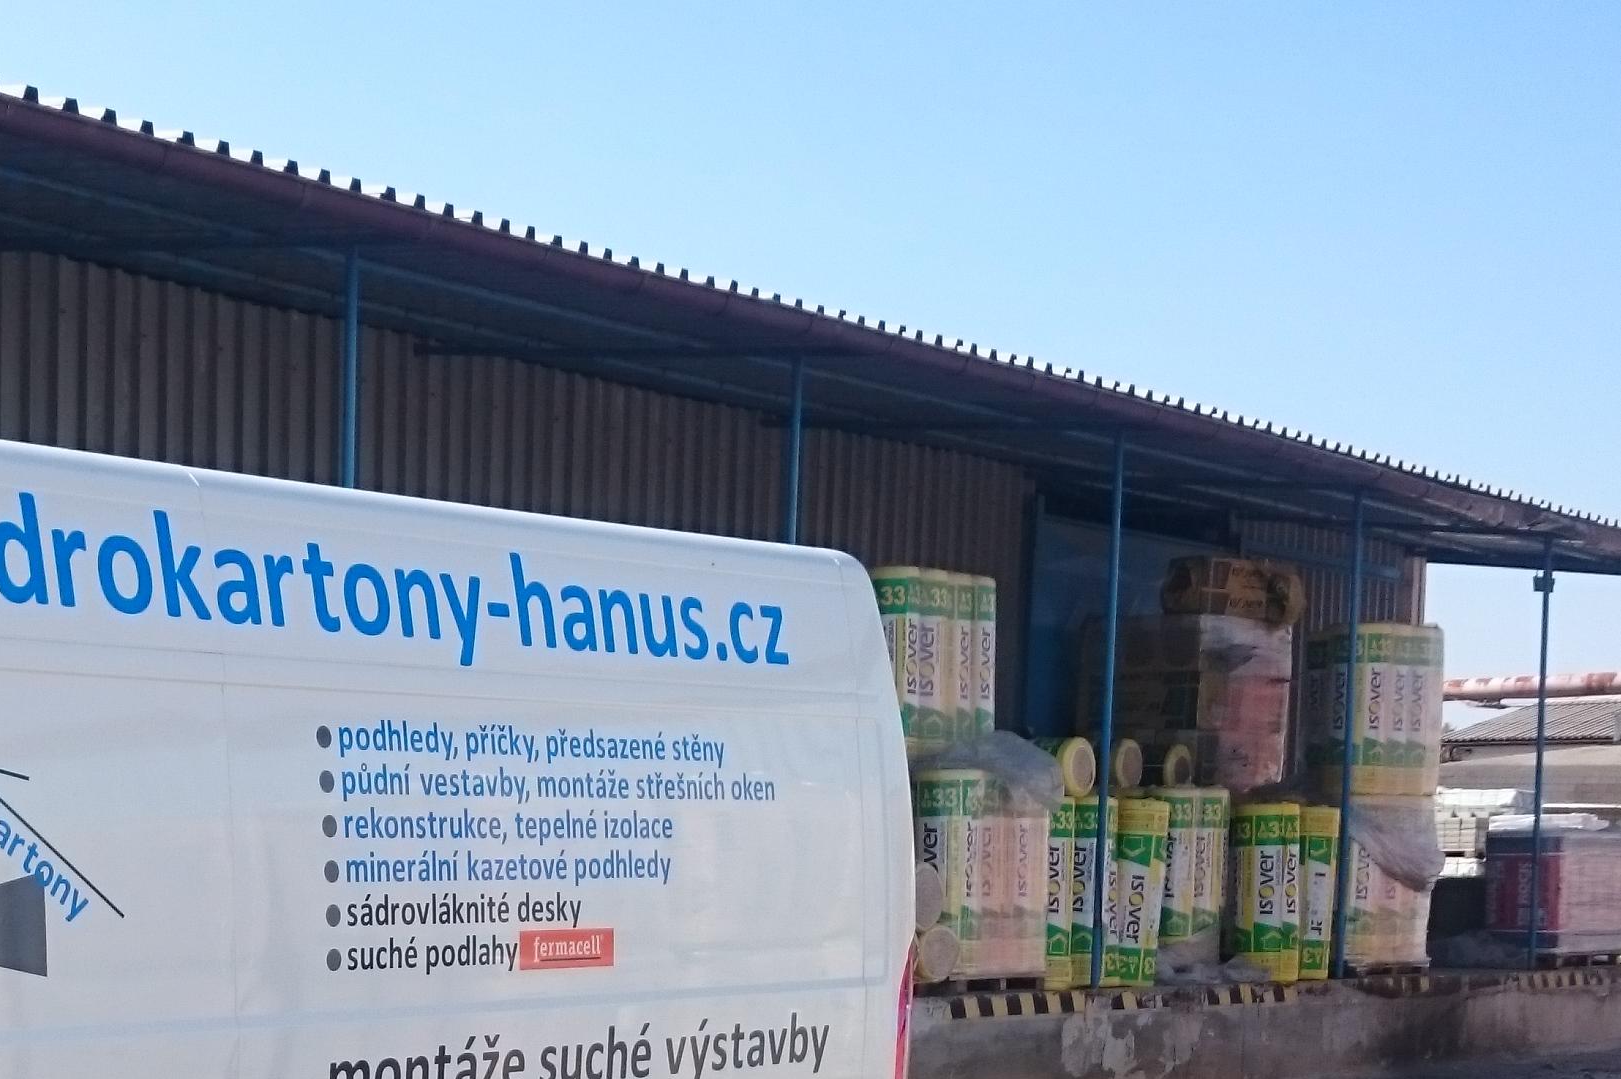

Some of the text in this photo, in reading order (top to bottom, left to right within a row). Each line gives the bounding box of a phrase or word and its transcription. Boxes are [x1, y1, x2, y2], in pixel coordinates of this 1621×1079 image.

[338, 720, 725, 768] podhledy, příčky, předsazené stěny
[341, 763, 775, 804] půdní vestavby, montáže střešních oken
[344, 807, 673, 845] rekonstrukce, tepelné izolace
[346, 849, 671, 886] minerální kazetové podhledy
[347, 892, 581, 928] sádrovláknité desky
[347, 935, 601, 975] suché podlahy fermacell
